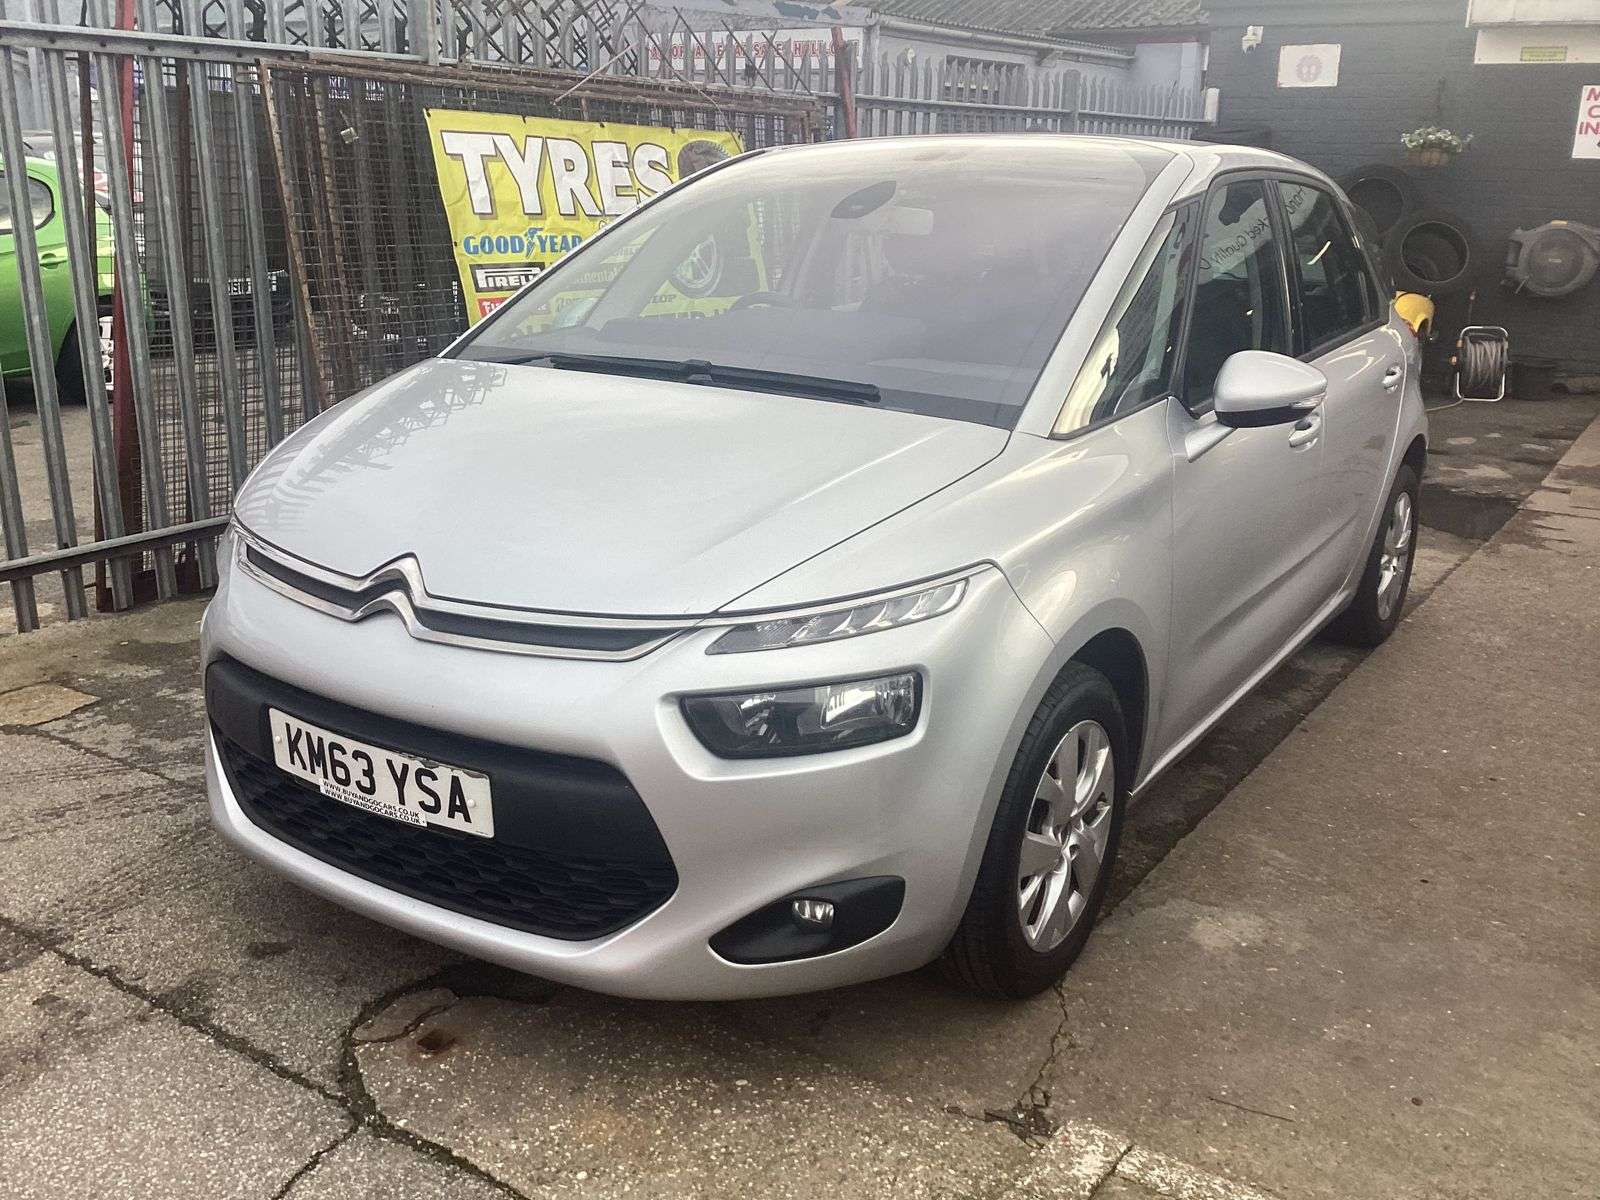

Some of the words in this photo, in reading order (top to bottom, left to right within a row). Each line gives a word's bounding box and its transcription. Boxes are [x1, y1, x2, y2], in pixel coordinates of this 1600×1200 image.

[1579, 122, 1600, 135] IN
[441, 131, 673, 217] TYRES
[285, 722, 376, 796] KM63
[386, 759, 472, 824] YSA
